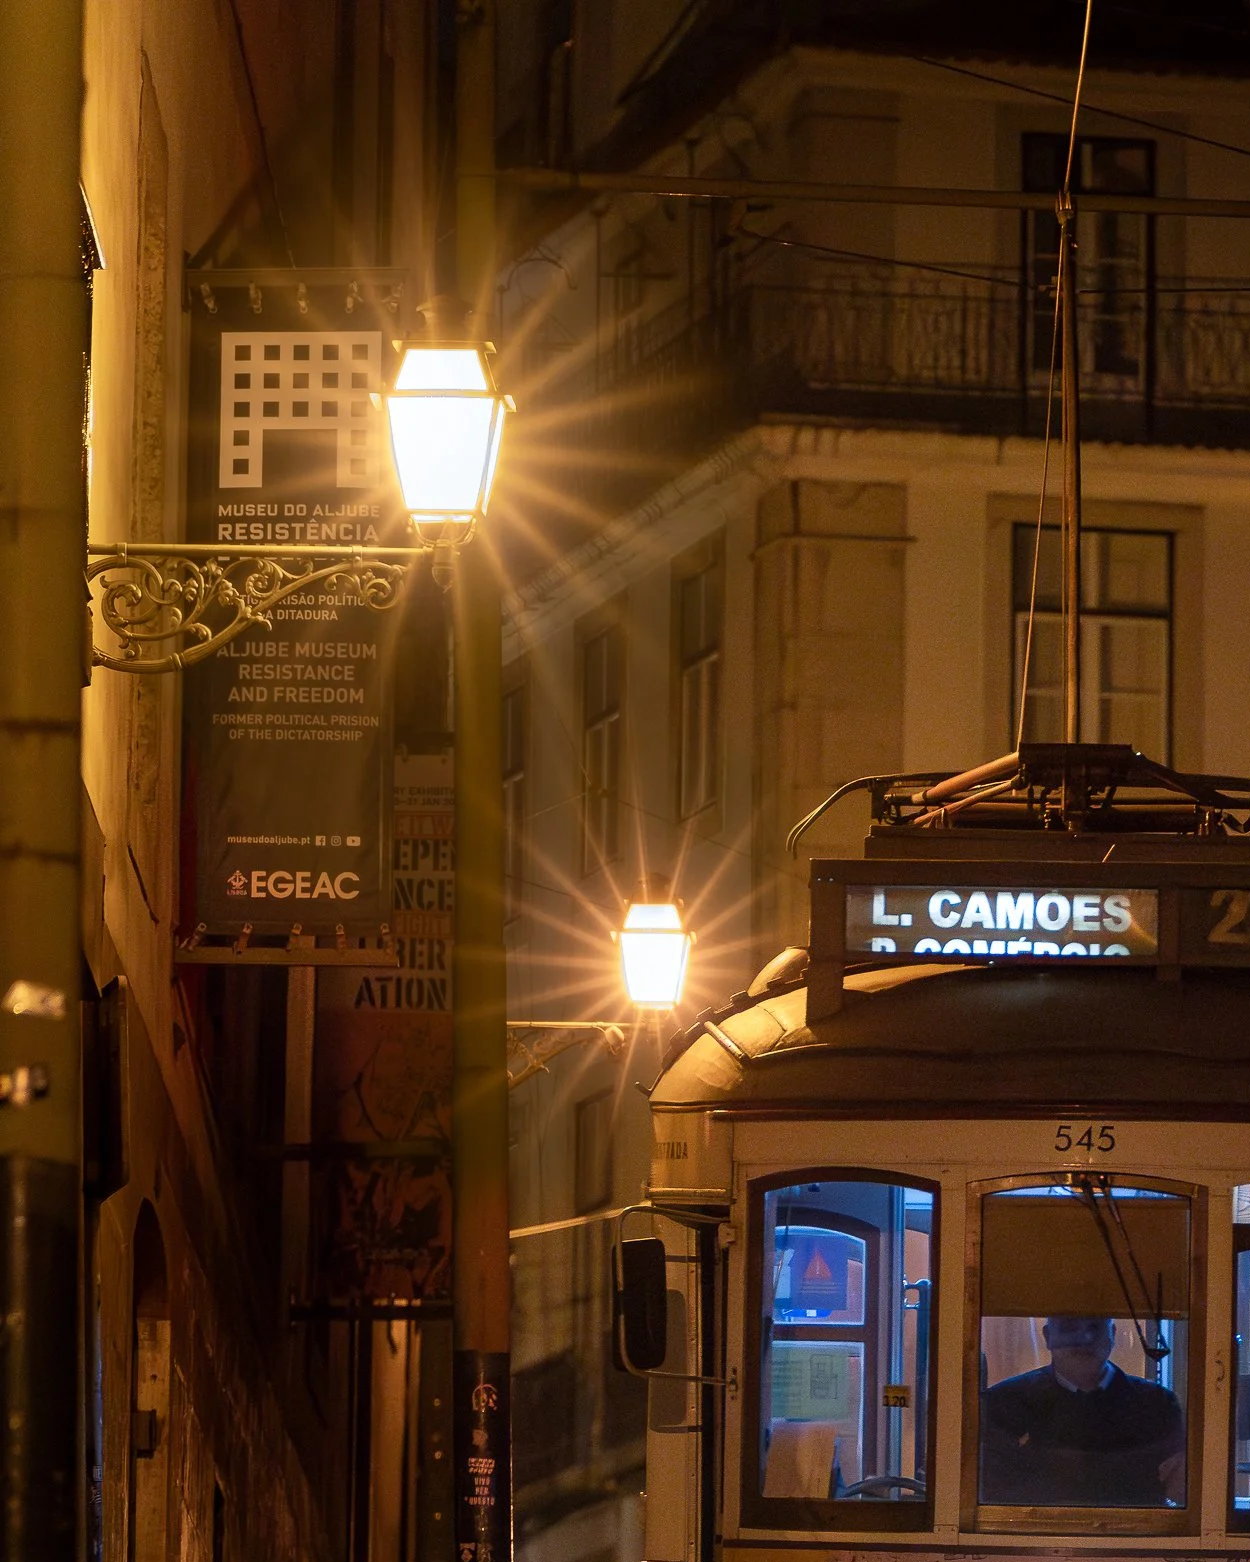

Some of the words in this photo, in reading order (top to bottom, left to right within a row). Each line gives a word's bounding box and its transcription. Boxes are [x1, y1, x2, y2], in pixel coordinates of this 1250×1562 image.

[218, 503, 278, 517] MUSEU
[284, 503, 307, 517] DO
[312, 504, 380, 518] ALJUBE
[217, 518, 380, 542] RESISTÊNCIA
[276, 609, 339, 621] DITADURA
[216, 641, 290, 658] ALJUBE
[295, 642, 377, 660] MUSEUM
[239, 664, 355, 682] RESISTANCE
[228, 686, 268, 703] AND
[273, 687, 365, 705] FREEDOM
[212, 713, 263, 725] FORMER
[265, 714, 328, 726] POLITICAL
[229, 729, 246, 740] OF
[248, 729, 272, 740] THE
[275, 729, 363, 742] DICTATORSHIP
[227, 835, 311, 846] museudoaljube.pt
[250, 870, 361, 900] EGEAC
[872, 882, 912, 926] L.
[1054, 1125, 1115, 1152] 545
